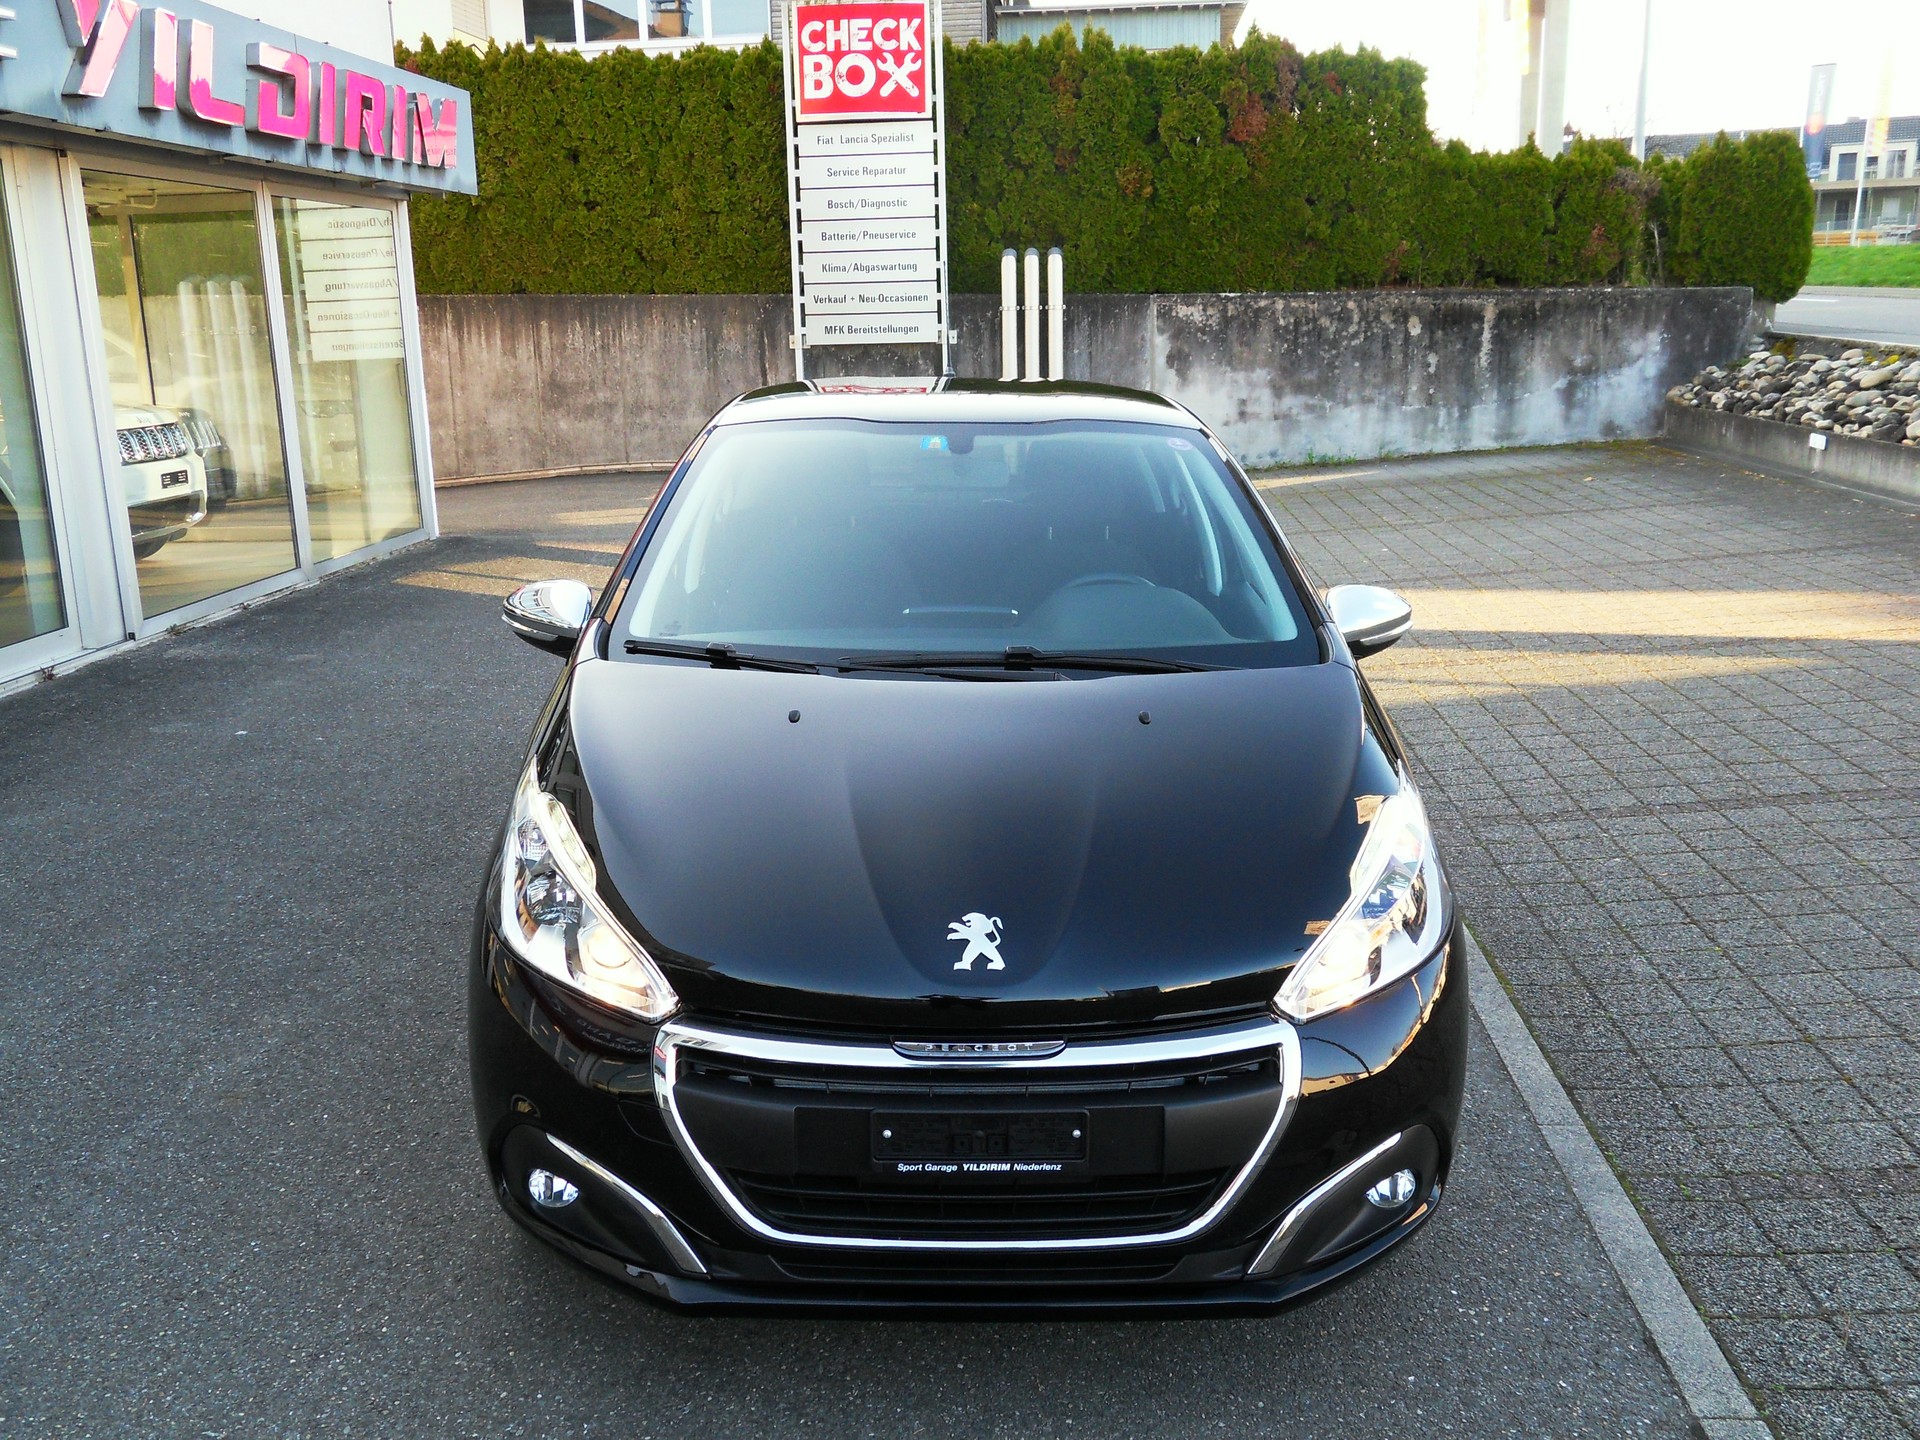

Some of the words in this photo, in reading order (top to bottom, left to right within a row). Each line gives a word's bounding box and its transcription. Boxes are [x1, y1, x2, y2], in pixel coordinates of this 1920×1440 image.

[800, 18, 922, 53] CHECK
[803, 52, 922, 100] BOX
[56, 0, 458, 169] YILDIRIM
[816, 135, 834, 145] Fiat
[840, 134, 869, 145] Lancia
[871, 132, 915, 145] Spezialist
[827, 167, 860, 177] Service
[862, 165, 907, 177] Reparatur
[827, 198, 908, 210] Bosch/Diagnostic
[821, 229, 917, 242] Batterie/Pneuservice
[821, 262, 918, 274] Klima/Abgaswartung
[813, 294, 847, 304] Verkauf
[858, 292, 929, 303] Neu-Occasionen
[824, 325, 845, 335] MFK
[847, 324, 920, 335] Bereitstellungen
[924, 1043, 1033, 1052] PEUGEOT
[897, 1163, 922, 1172] Sport
[924, 1163, 958, 1172] Garage
[962, 1163, 1010, 1171] YILDIRIM
[1013, 1163, 1062, 1171] Niederlenz
